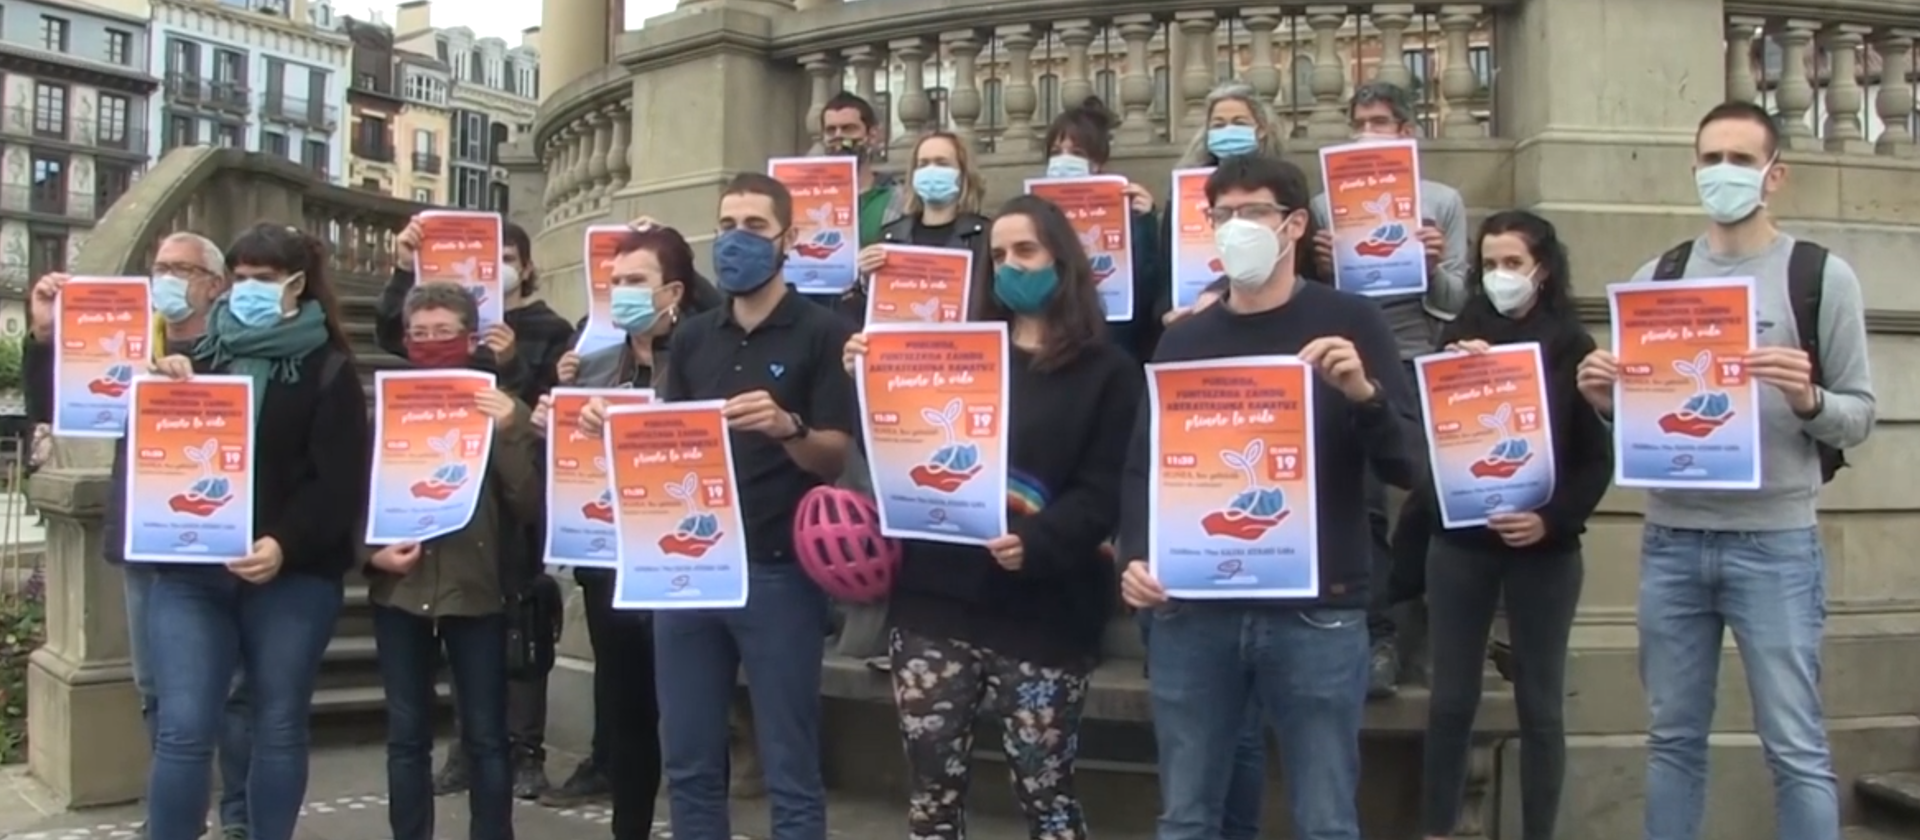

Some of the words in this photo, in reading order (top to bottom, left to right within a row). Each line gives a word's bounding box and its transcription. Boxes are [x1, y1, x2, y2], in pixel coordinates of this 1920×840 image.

[1722, 365, 1739, 376] 19
[973, 414, 991, 426] 19
[1519, 413, 1536, 423] 19
[466, 440, 480, 450] 19
[225, 452, 240, 463] 19
[1276, 456, 1296, 470] 19
[708, 487, 723, 497] 19
